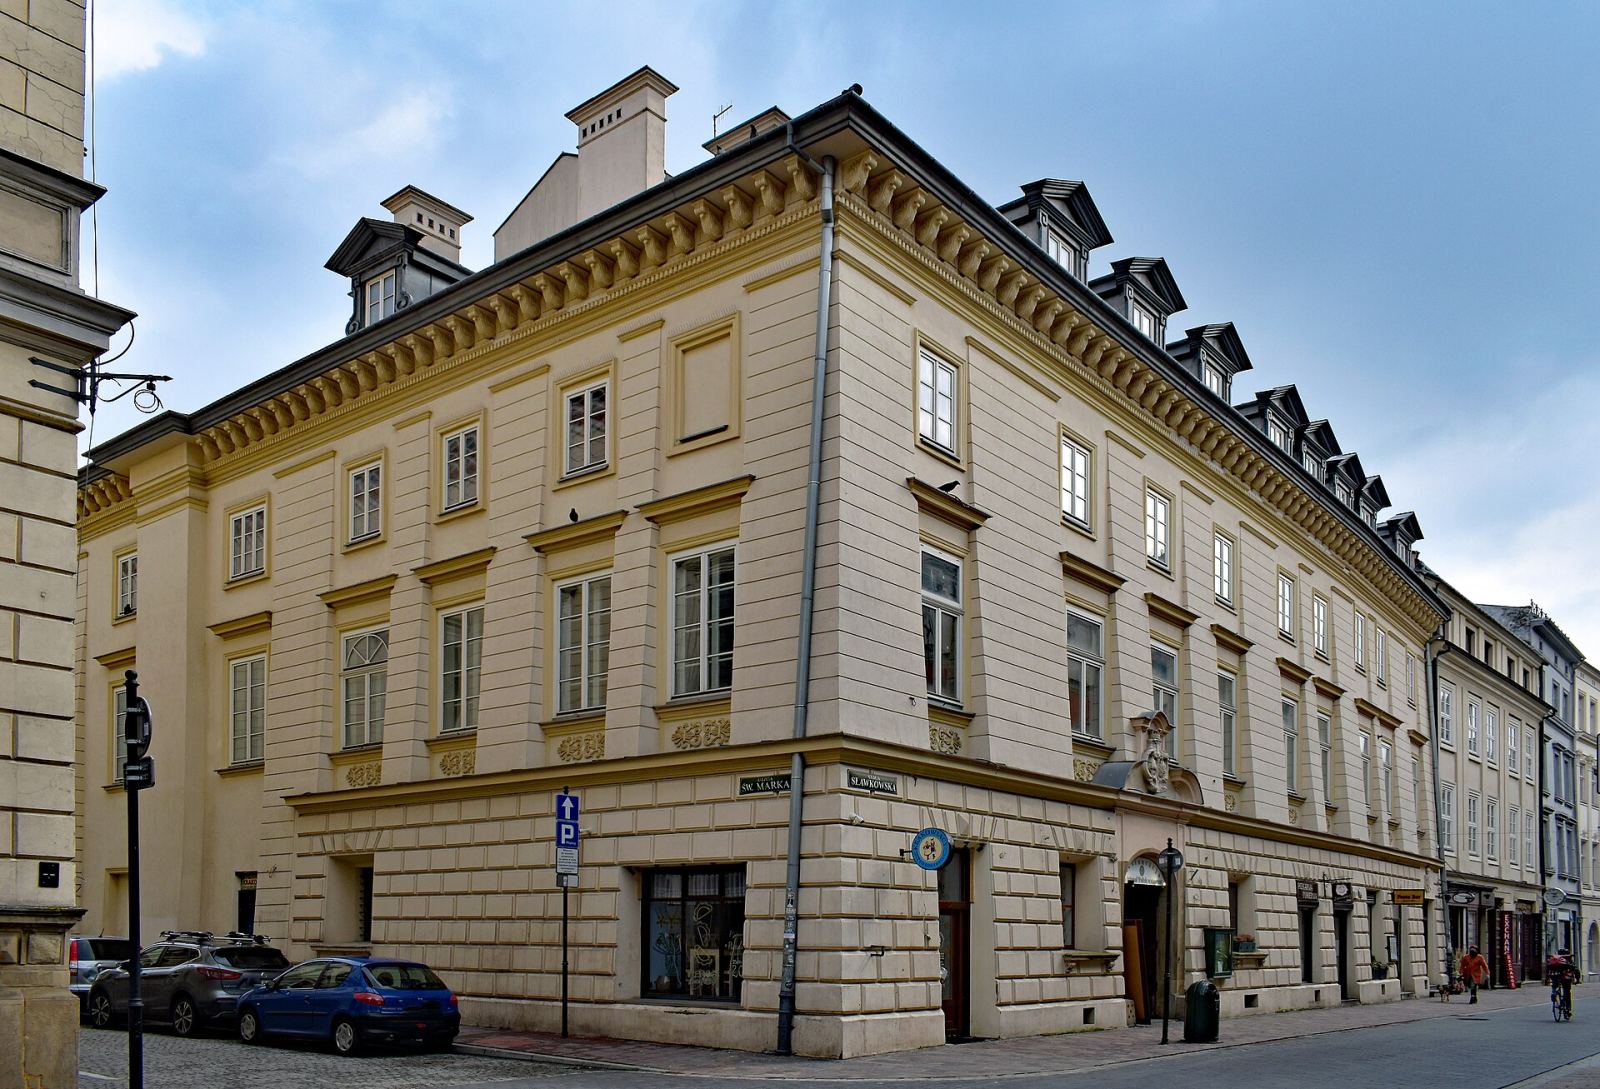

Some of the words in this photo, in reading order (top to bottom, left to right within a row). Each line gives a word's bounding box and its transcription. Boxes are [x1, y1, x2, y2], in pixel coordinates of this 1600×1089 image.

[756, 780, 790, 791] MARKA
[851, 776, 897, 792] SŁAWKOWSKA
[561, 824, 575, 845] P
